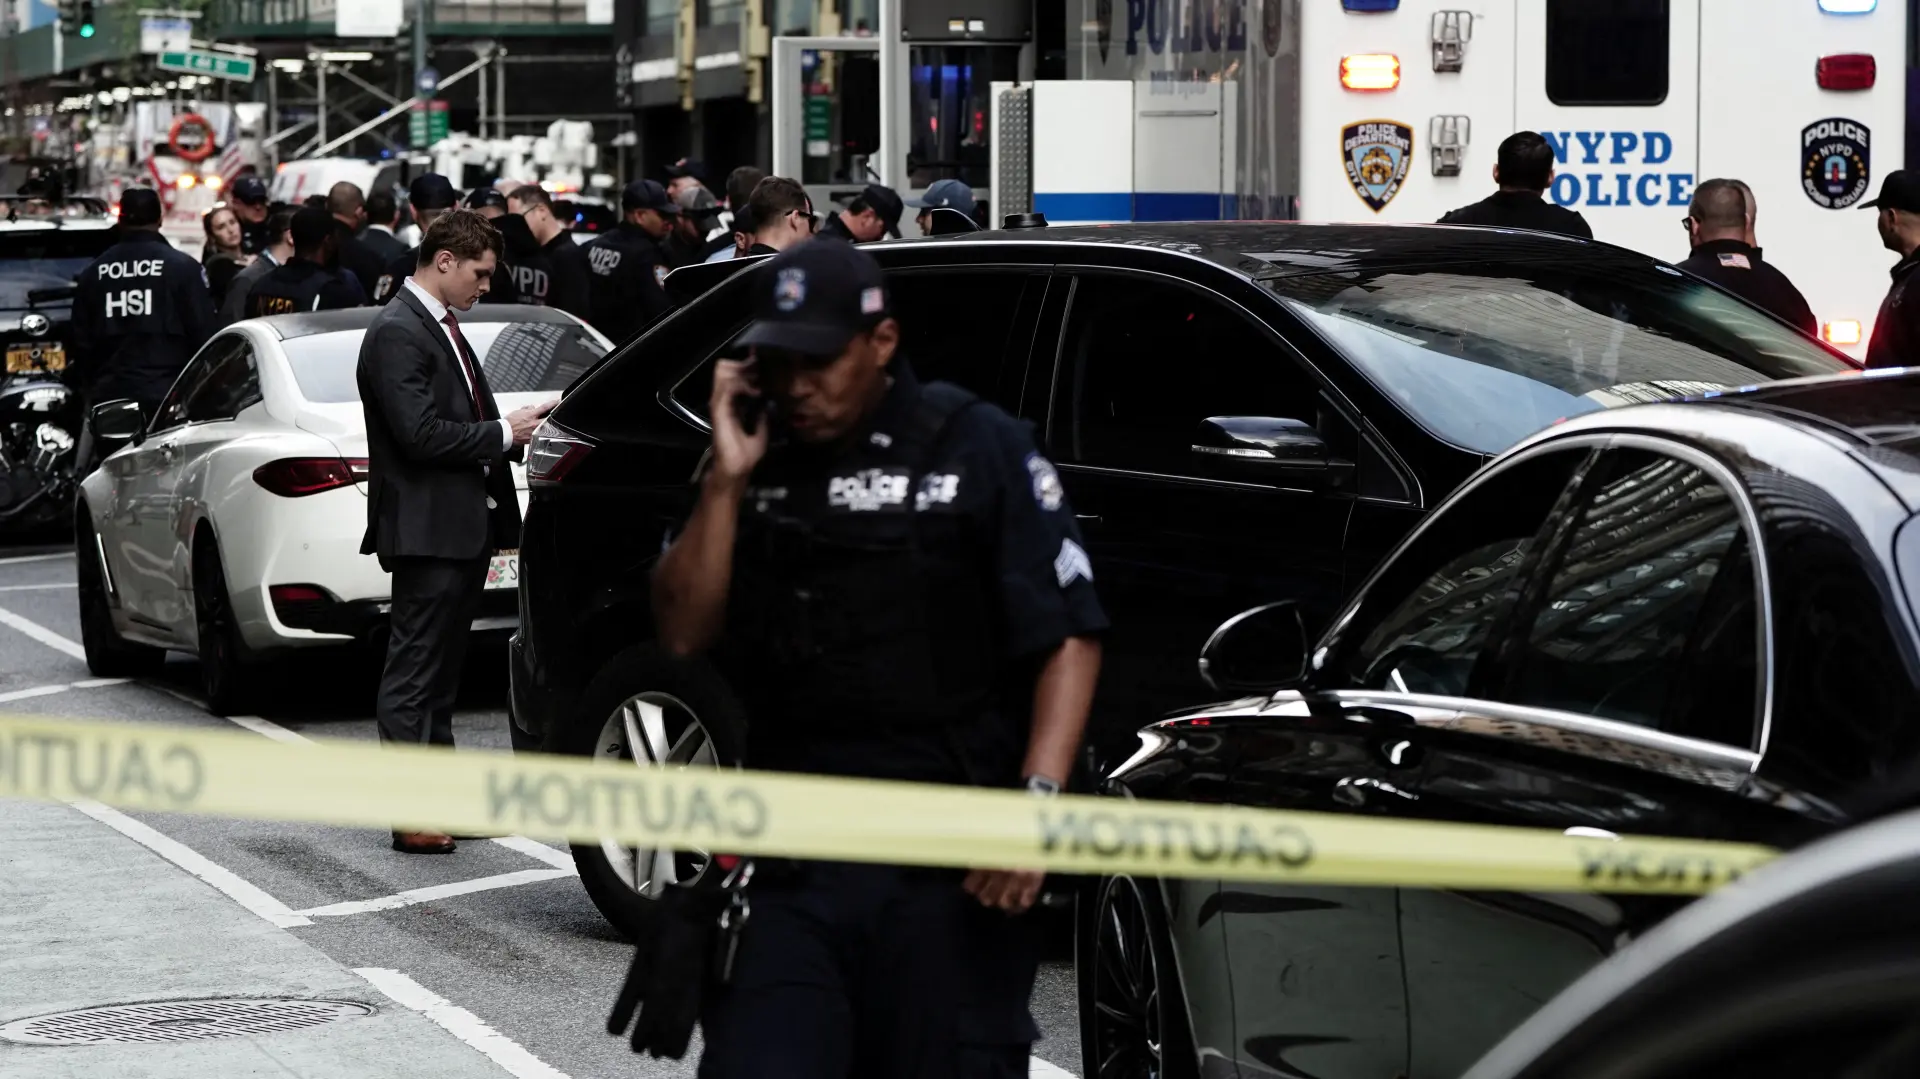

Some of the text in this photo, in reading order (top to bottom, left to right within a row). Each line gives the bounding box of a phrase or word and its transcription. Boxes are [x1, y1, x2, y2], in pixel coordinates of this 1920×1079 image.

[1126, 0, 1247, 55] POLICE
[1344, 133, 1410, 151] DEPARTMENT
[1358, 124, 1397, 136] POLICE
[1805, 121, 1867, 148] POLICE
[1541, 132, 1672, 164] NYPD
[1819, 143, 1853, 157] NYPD
[1550, 173, 1693, 206] OLICE
[1834, 178, 1866, 208] SQUAD
[98, 259, 164, 280] POLICE
[588, 246, 621, 270] NYPD
[510, 265, 549, 297] YPD
[106, 289, 152, 318] HSI
